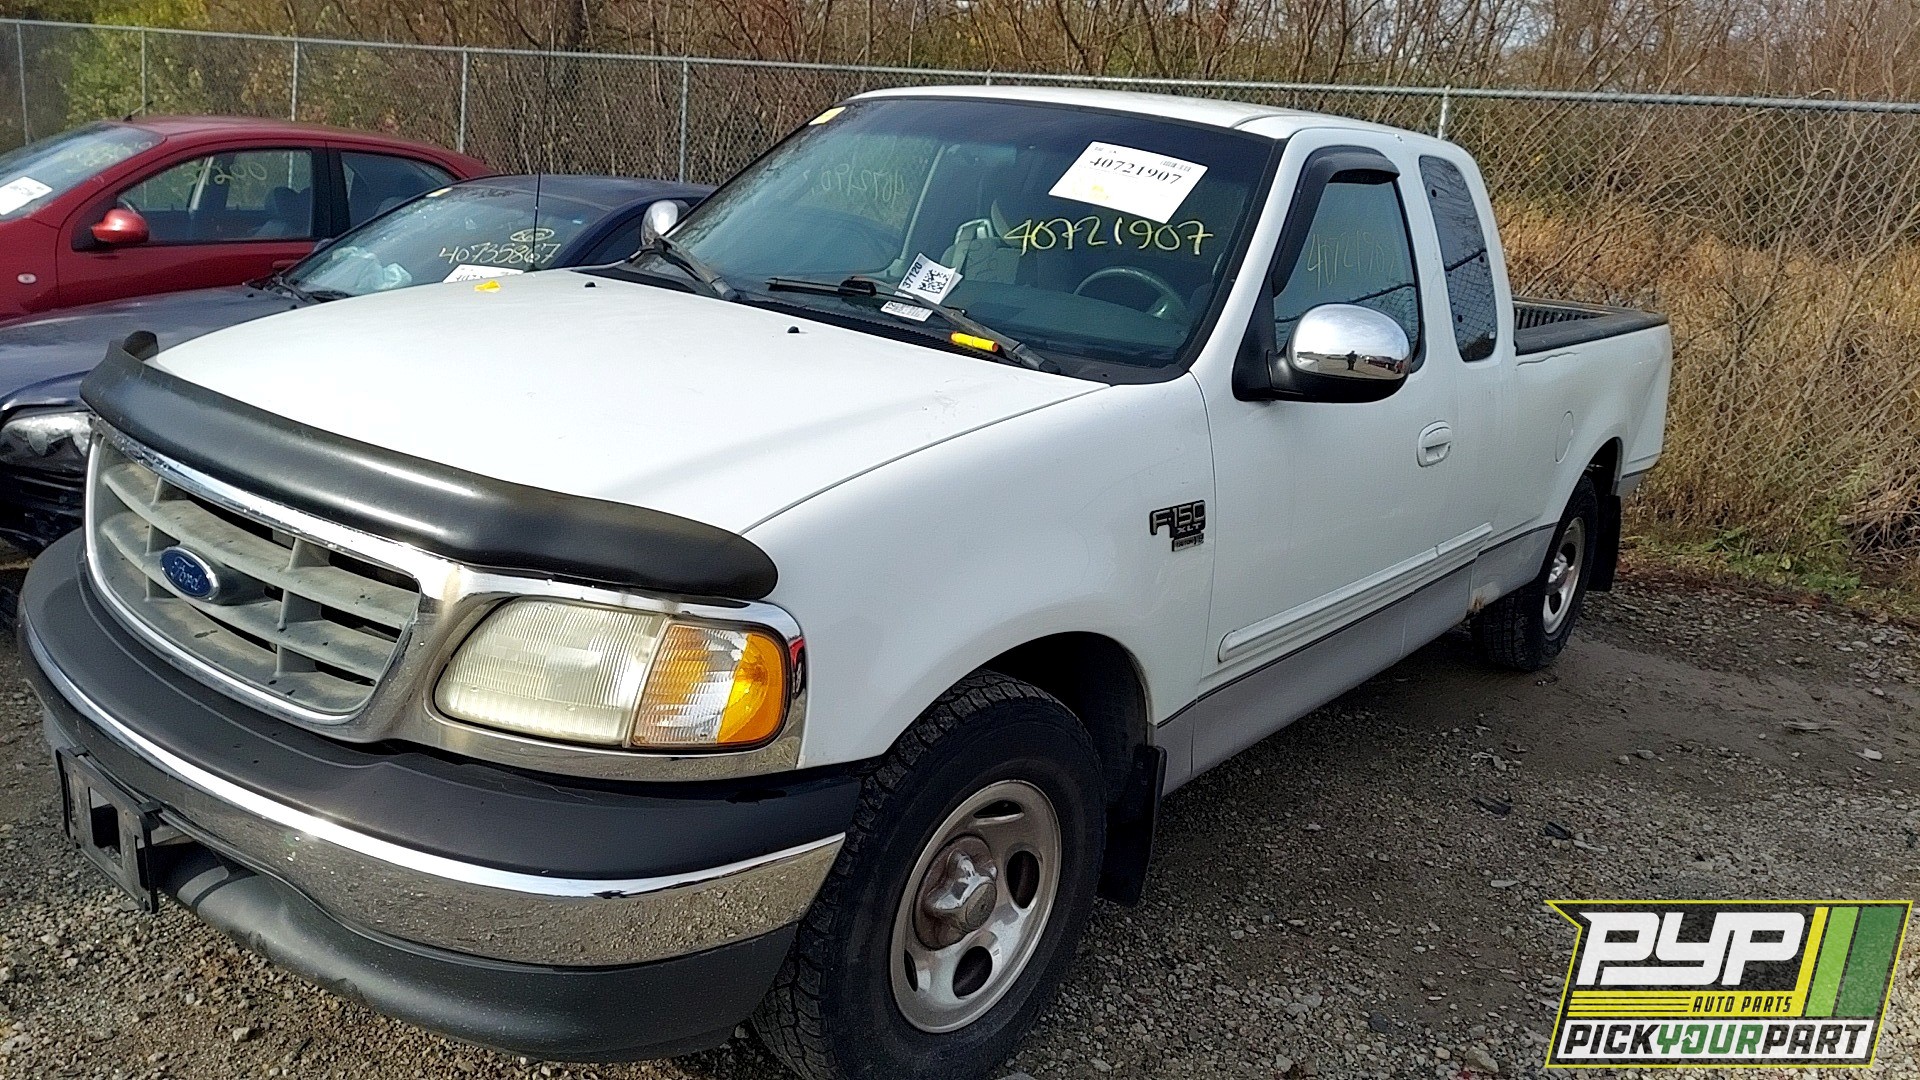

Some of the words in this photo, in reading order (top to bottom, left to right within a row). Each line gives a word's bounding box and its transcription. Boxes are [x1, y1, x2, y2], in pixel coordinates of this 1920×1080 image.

[1090, 157, 1182, 185] 40721907
[1003, 215, 1214, 256] 40721907
[438, 241, 562, 264] 40735867
[903, 261, 923, 289] 37120
[1176, 522, 1202, 535] XLT
[171, 556, 203, 591] Ford
